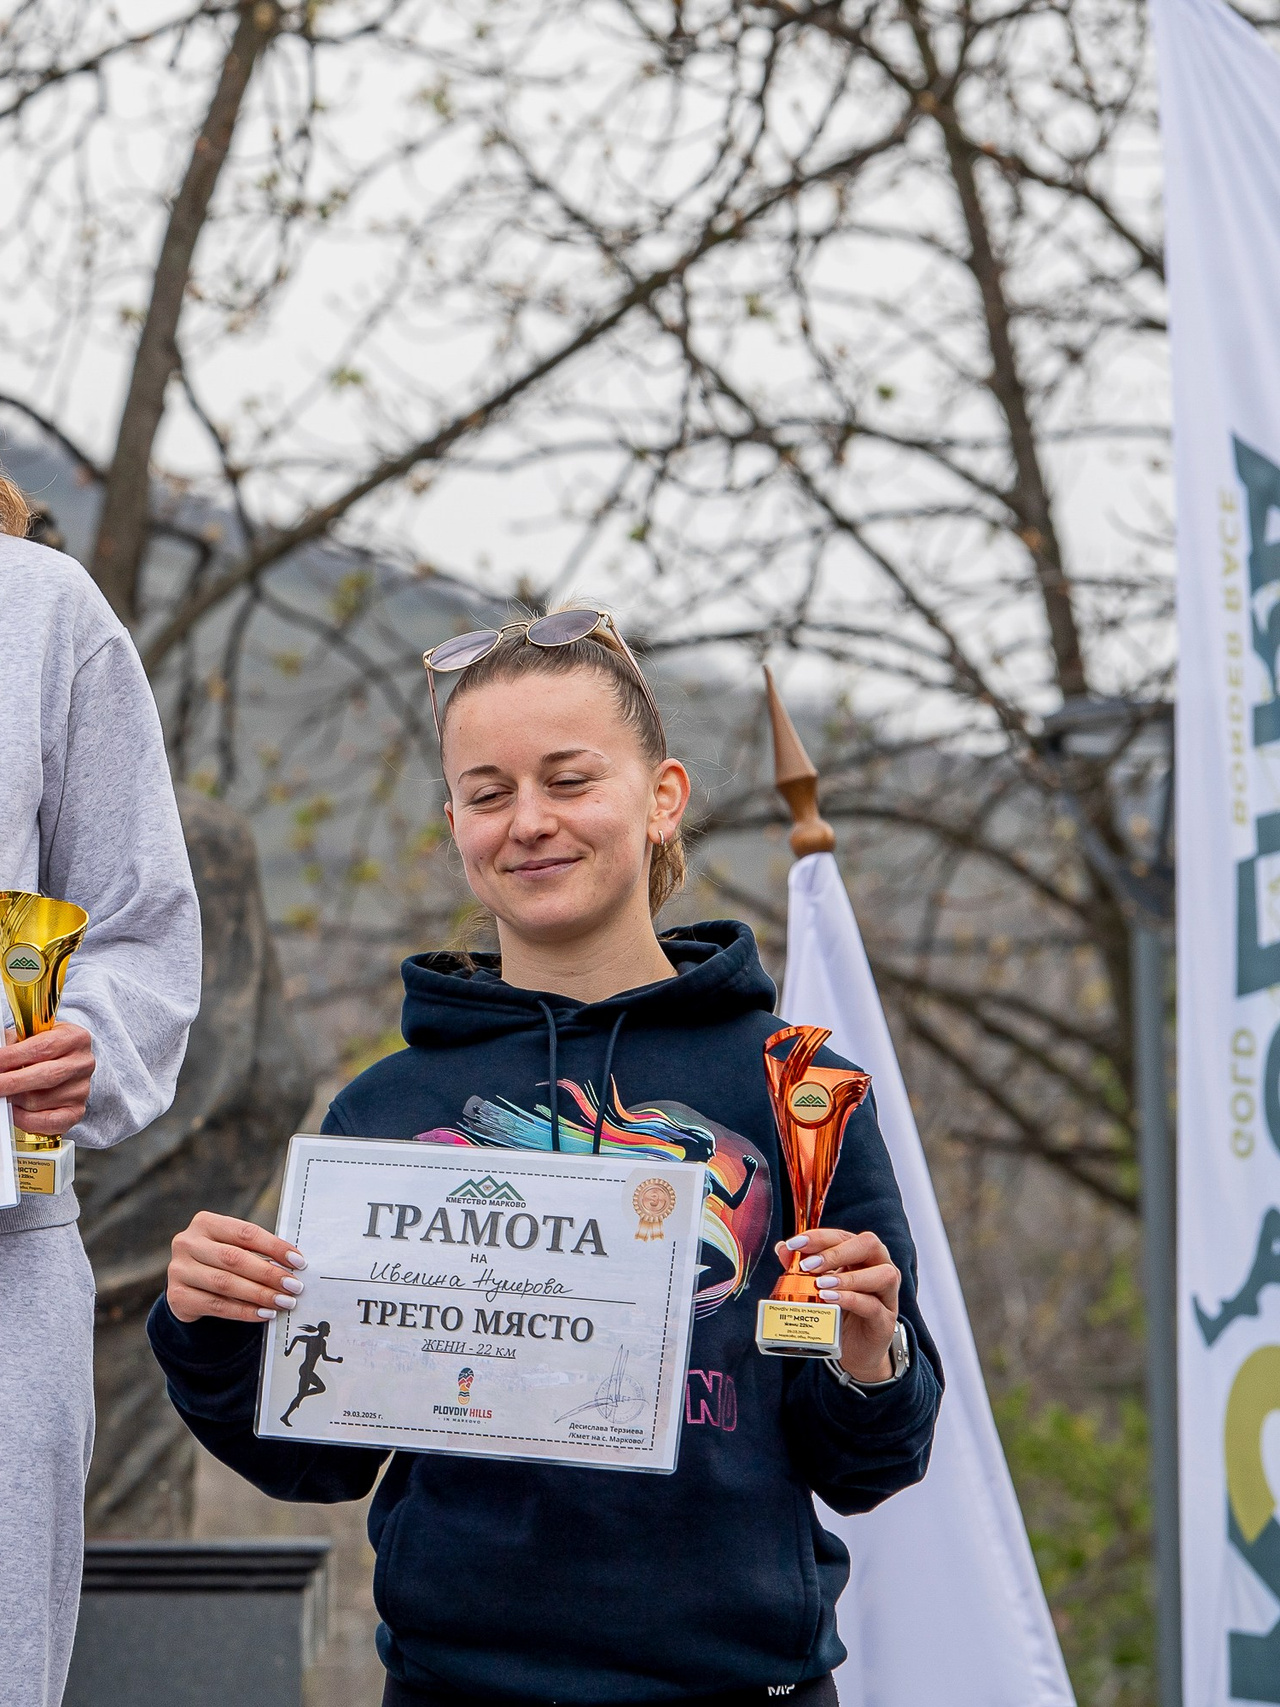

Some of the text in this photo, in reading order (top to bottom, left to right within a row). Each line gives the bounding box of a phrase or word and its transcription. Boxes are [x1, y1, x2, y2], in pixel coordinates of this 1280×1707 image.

[445, 1196, 527, 1208] КМЕТСТВО МАРКОВО
[362, 1202, 609, 1257] ГРАМОТА
[470, 1253, 488, 1264] НА
[370, 1261, 466, 1288] Ивелина
[357, 1299, 595, 1344] ТРЕТО МЯСТО
[422, 1338, 467, 1353] ЖЕНИ
[476, 1343, 492, 1356] 22
[496, 1346, 517, 1359] км
[343, 1410, 377, 1419] 29.03.2025
[433, 1405, 492, 1419] PLOVDIV HILLS
[569, 1422, 644, 1434] Десислава Терзиева
[568, 1432, 589, 1440] /Кмет
[609, 1436, 644, 1444] Марково/
